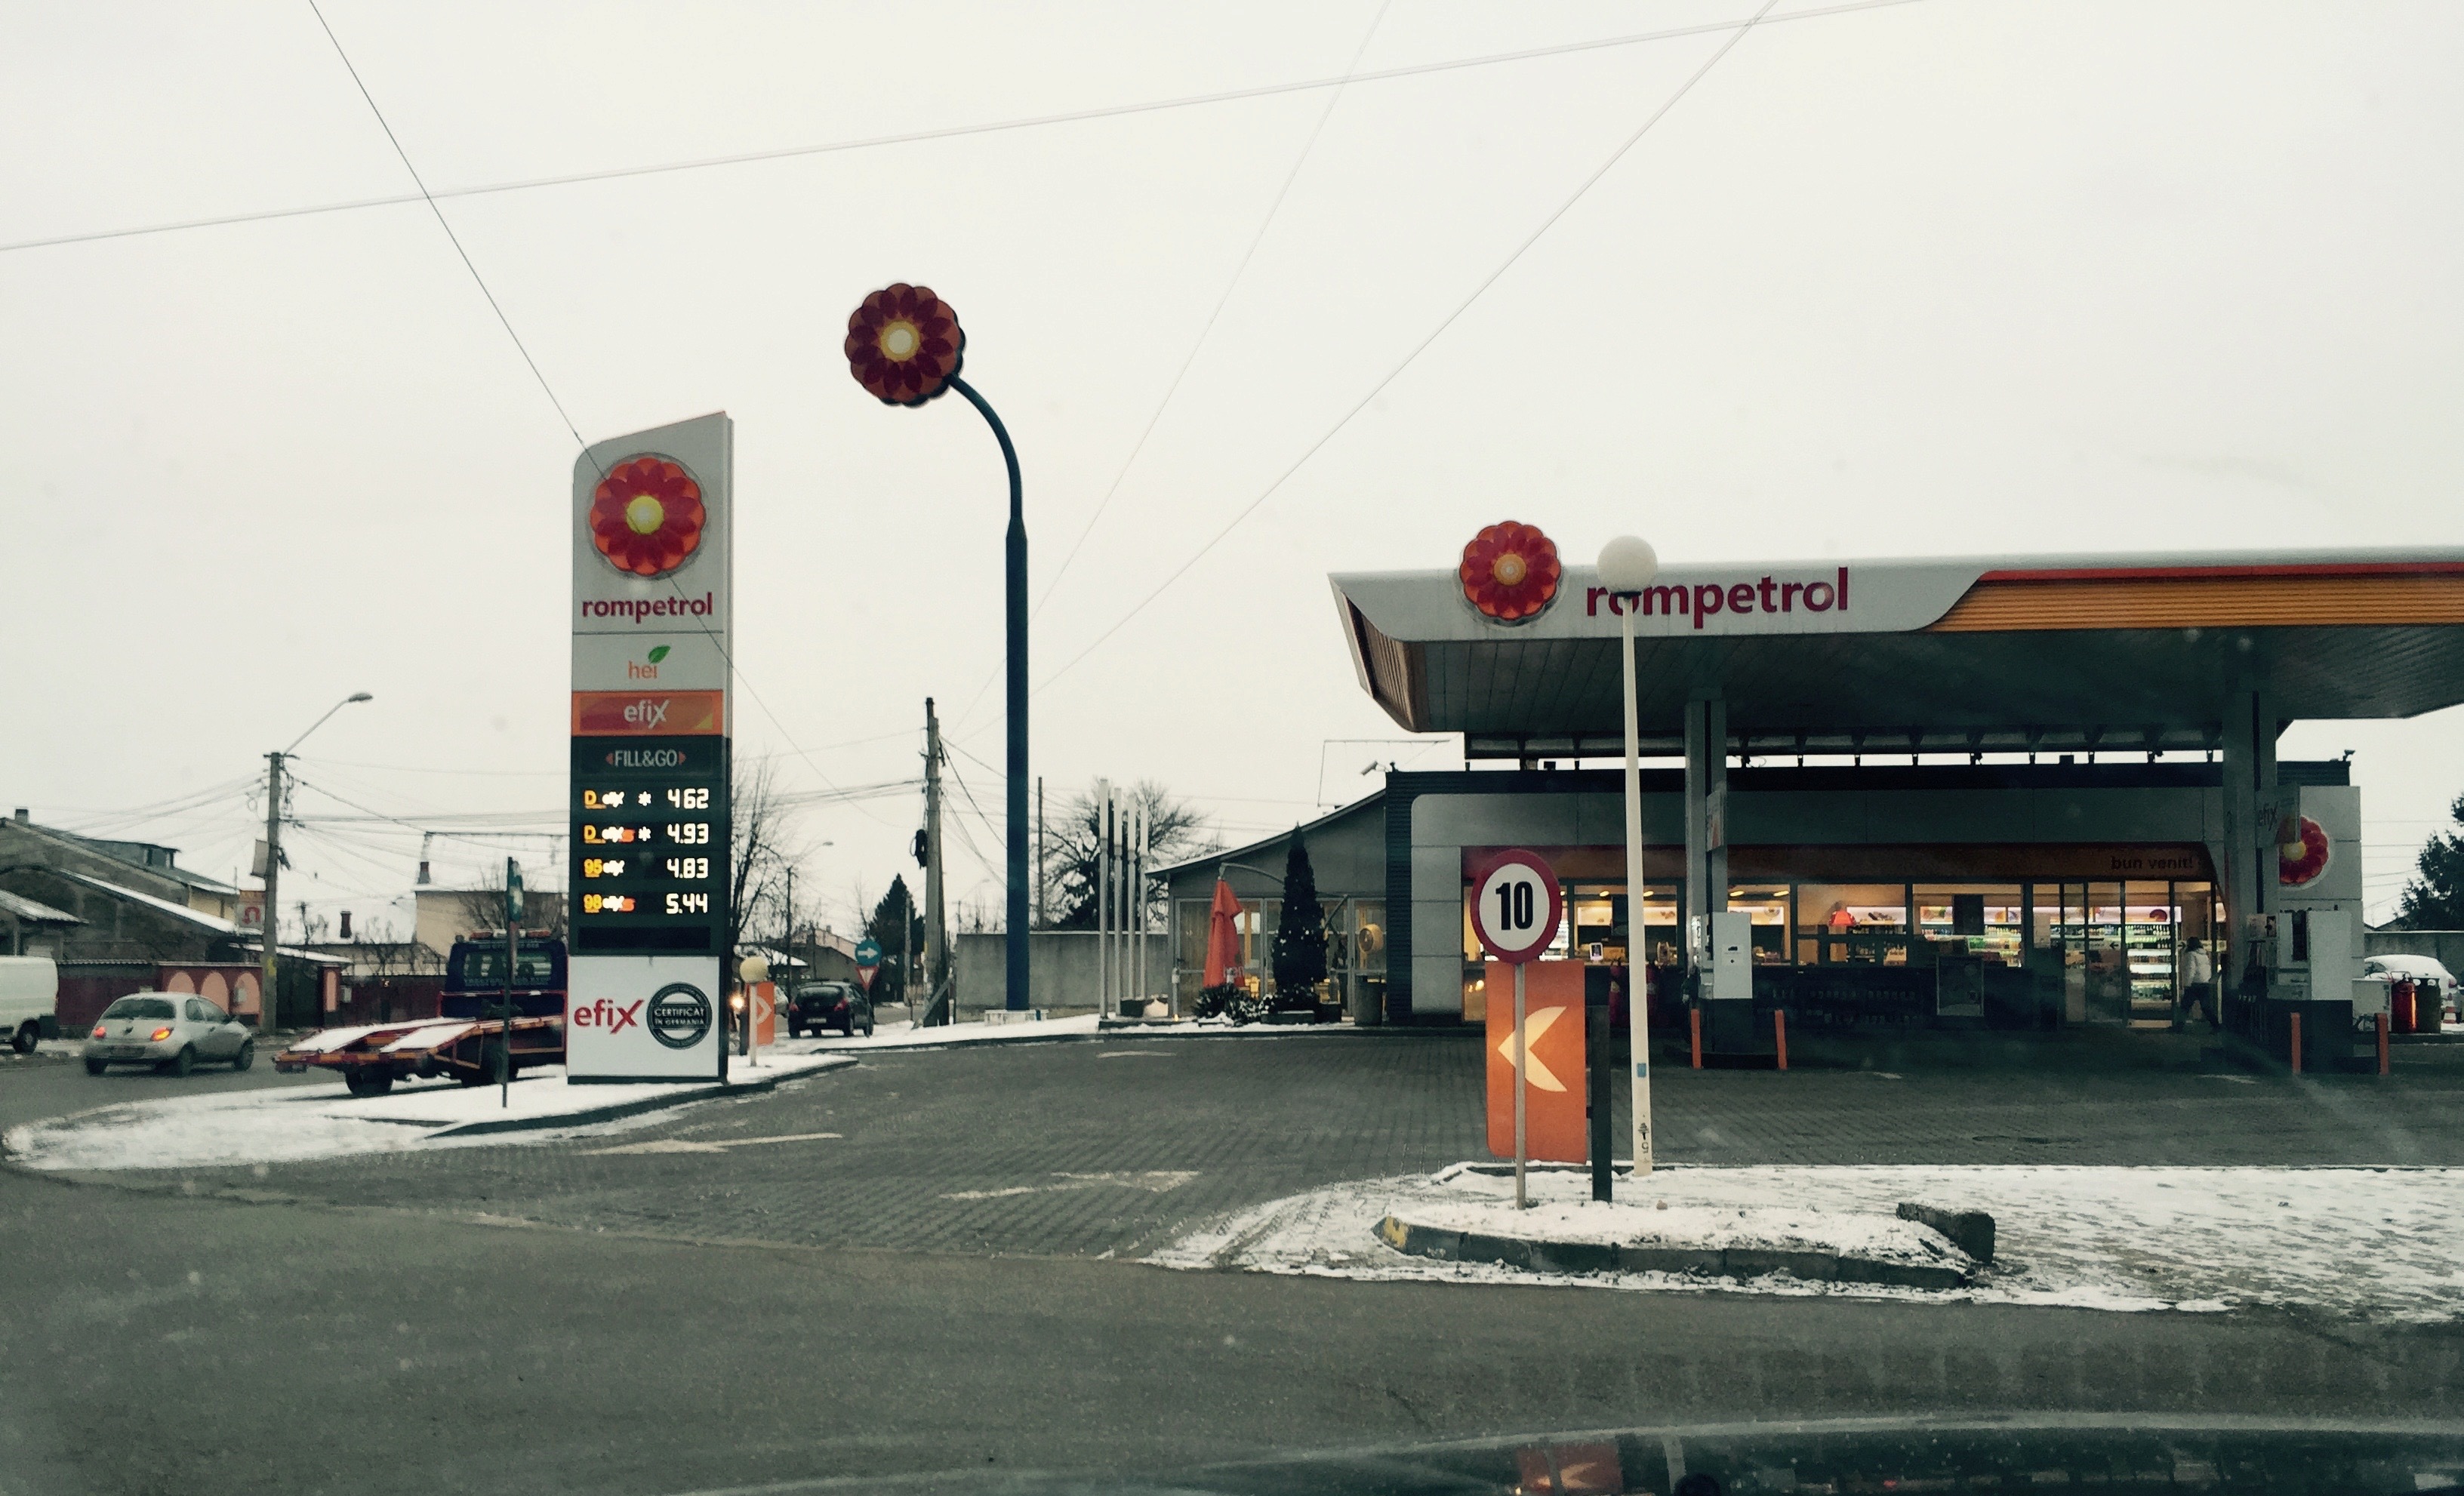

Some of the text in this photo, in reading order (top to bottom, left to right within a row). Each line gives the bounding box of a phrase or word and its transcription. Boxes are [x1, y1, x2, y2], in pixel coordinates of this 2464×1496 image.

[582, 593, 713, 623] rompetrol
[1586, 567, 1849, 629] rompetrol
[624, 700, 670, 729] efix
[614, 750, 678, 768] FILL&GO
[667, 823, 708, 844] 4.93
[584, 859, 602, 874] 95
[667, 857, 708, 879] 4.83
[2110, 856, 2193, 870] bun venit!
[584, 894, 602, 910] 98
[666, 893, 708, 914] 5.44
[1495, 881, 1533, 931] 10
[573, 997, 645, 1035] efix
[654, 1007, 704, 1017] CERTIFICAT
